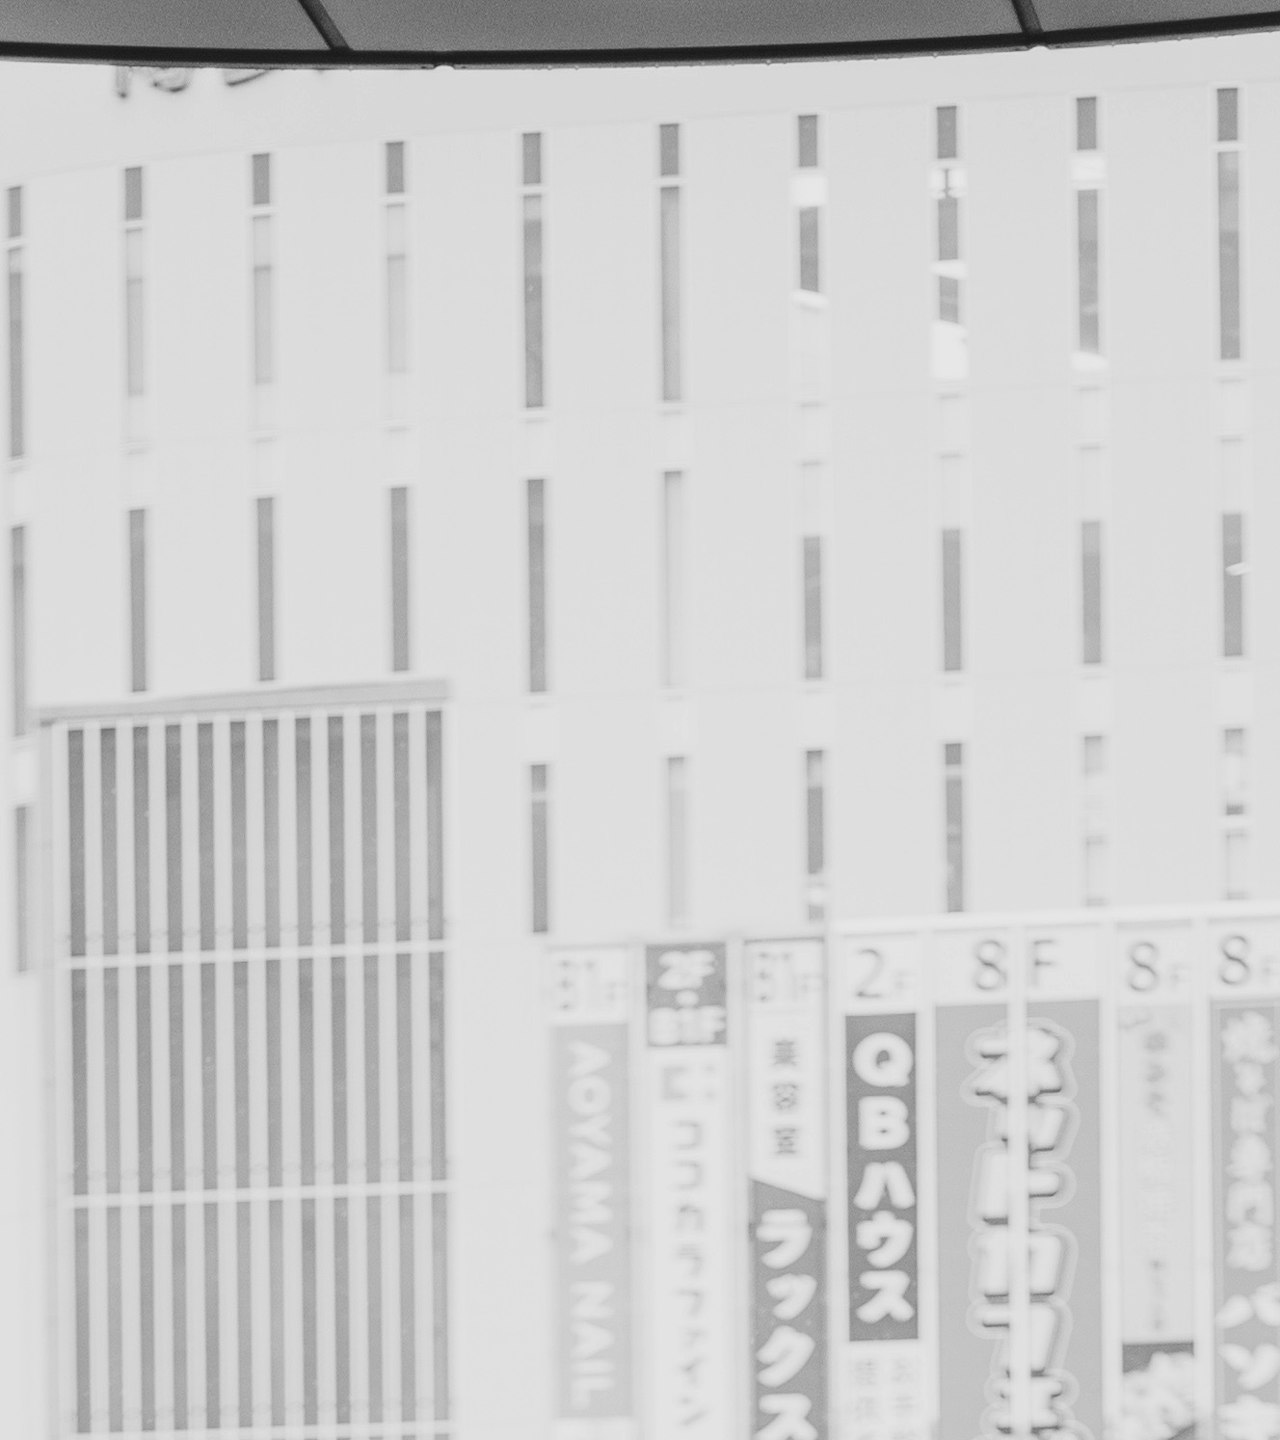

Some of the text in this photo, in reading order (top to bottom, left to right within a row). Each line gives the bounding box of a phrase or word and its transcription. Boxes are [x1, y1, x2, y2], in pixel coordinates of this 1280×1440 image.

[972, 937, 1061, 992] 8F
[567, 1039, 617, 1407] AOYAMA NAIL
[852, 1031, 914, 1324] QBハウス
